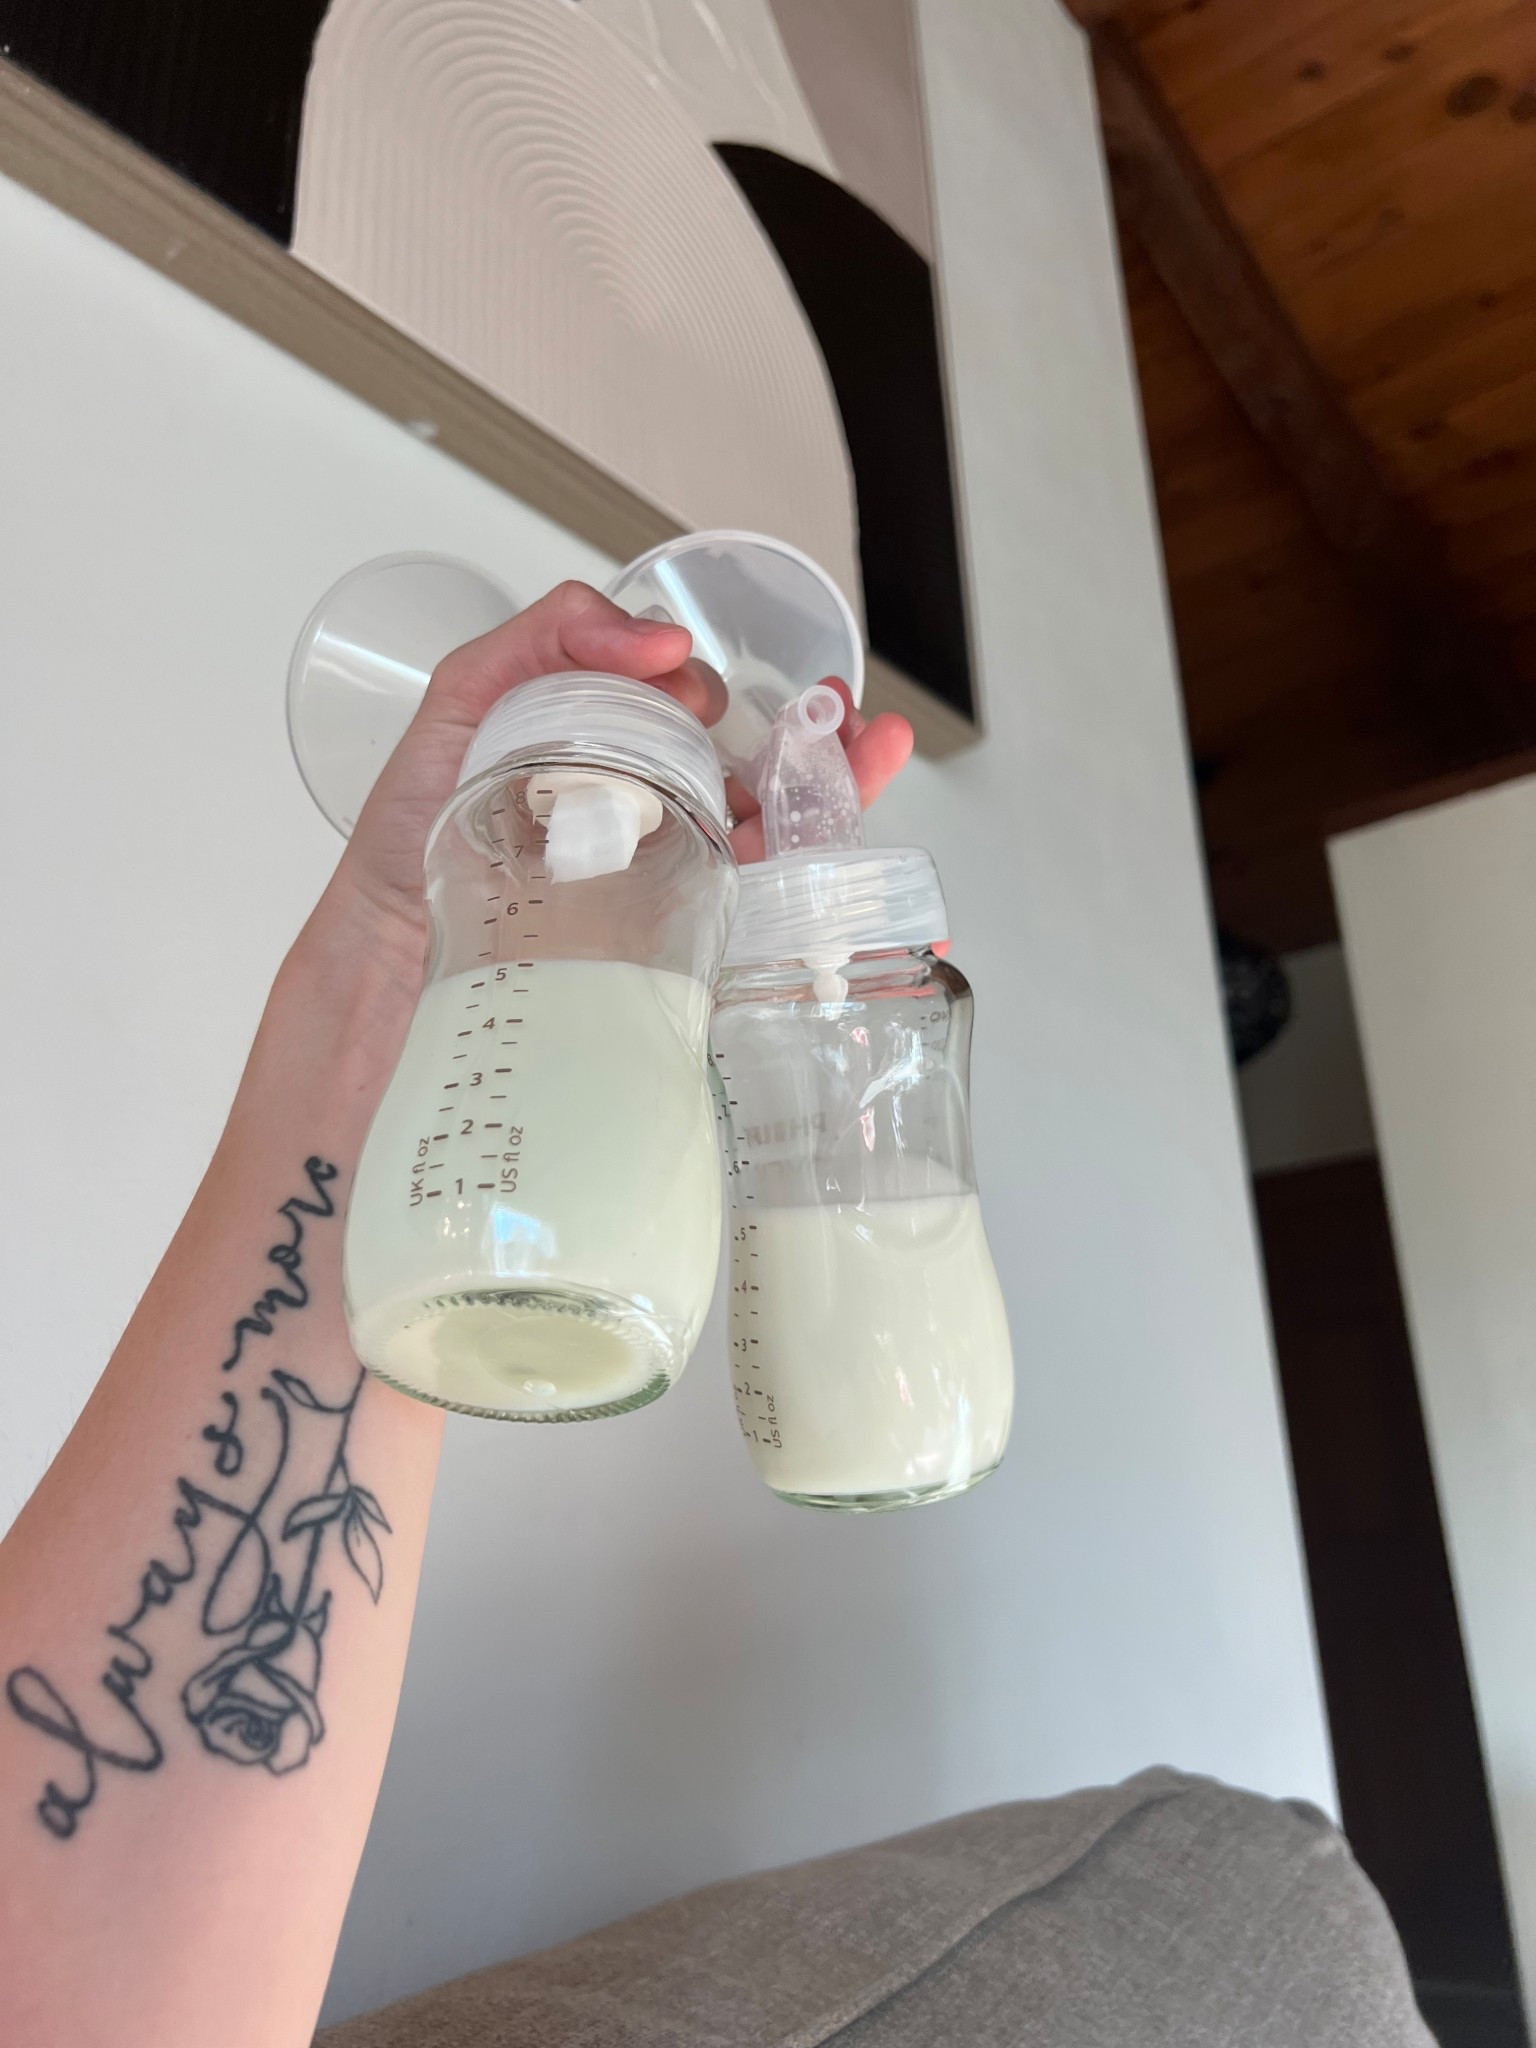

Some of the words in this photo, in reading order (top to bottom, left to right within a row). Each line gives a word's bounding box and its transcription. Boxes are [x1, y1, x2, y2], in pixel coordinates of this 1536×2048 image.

[515, 791, 527, 805] 8
[513, 845, 525, 858] 7
[506, 902, 519, 916] 6
[495, 967, 508, 981] 5
[482, 1016, 496, 1030] 4
[469, 1072, 483, 1086] 3
[460, 1119, 474, 1135] 2
[500, 1167, 518, 1193] US
[509, 1126, 523, 1146] oz
[409, 1177, 425, 1207] UK
[417, 1136, 430, 1157] oz
[454, 1177, 465, 1195] 1
[222, 1155, 337, 1370] more
[766, 1395, 775, 1412] oz
[770, 1429, 783, 1449] US
[6, 1387, 288, 1840] always
